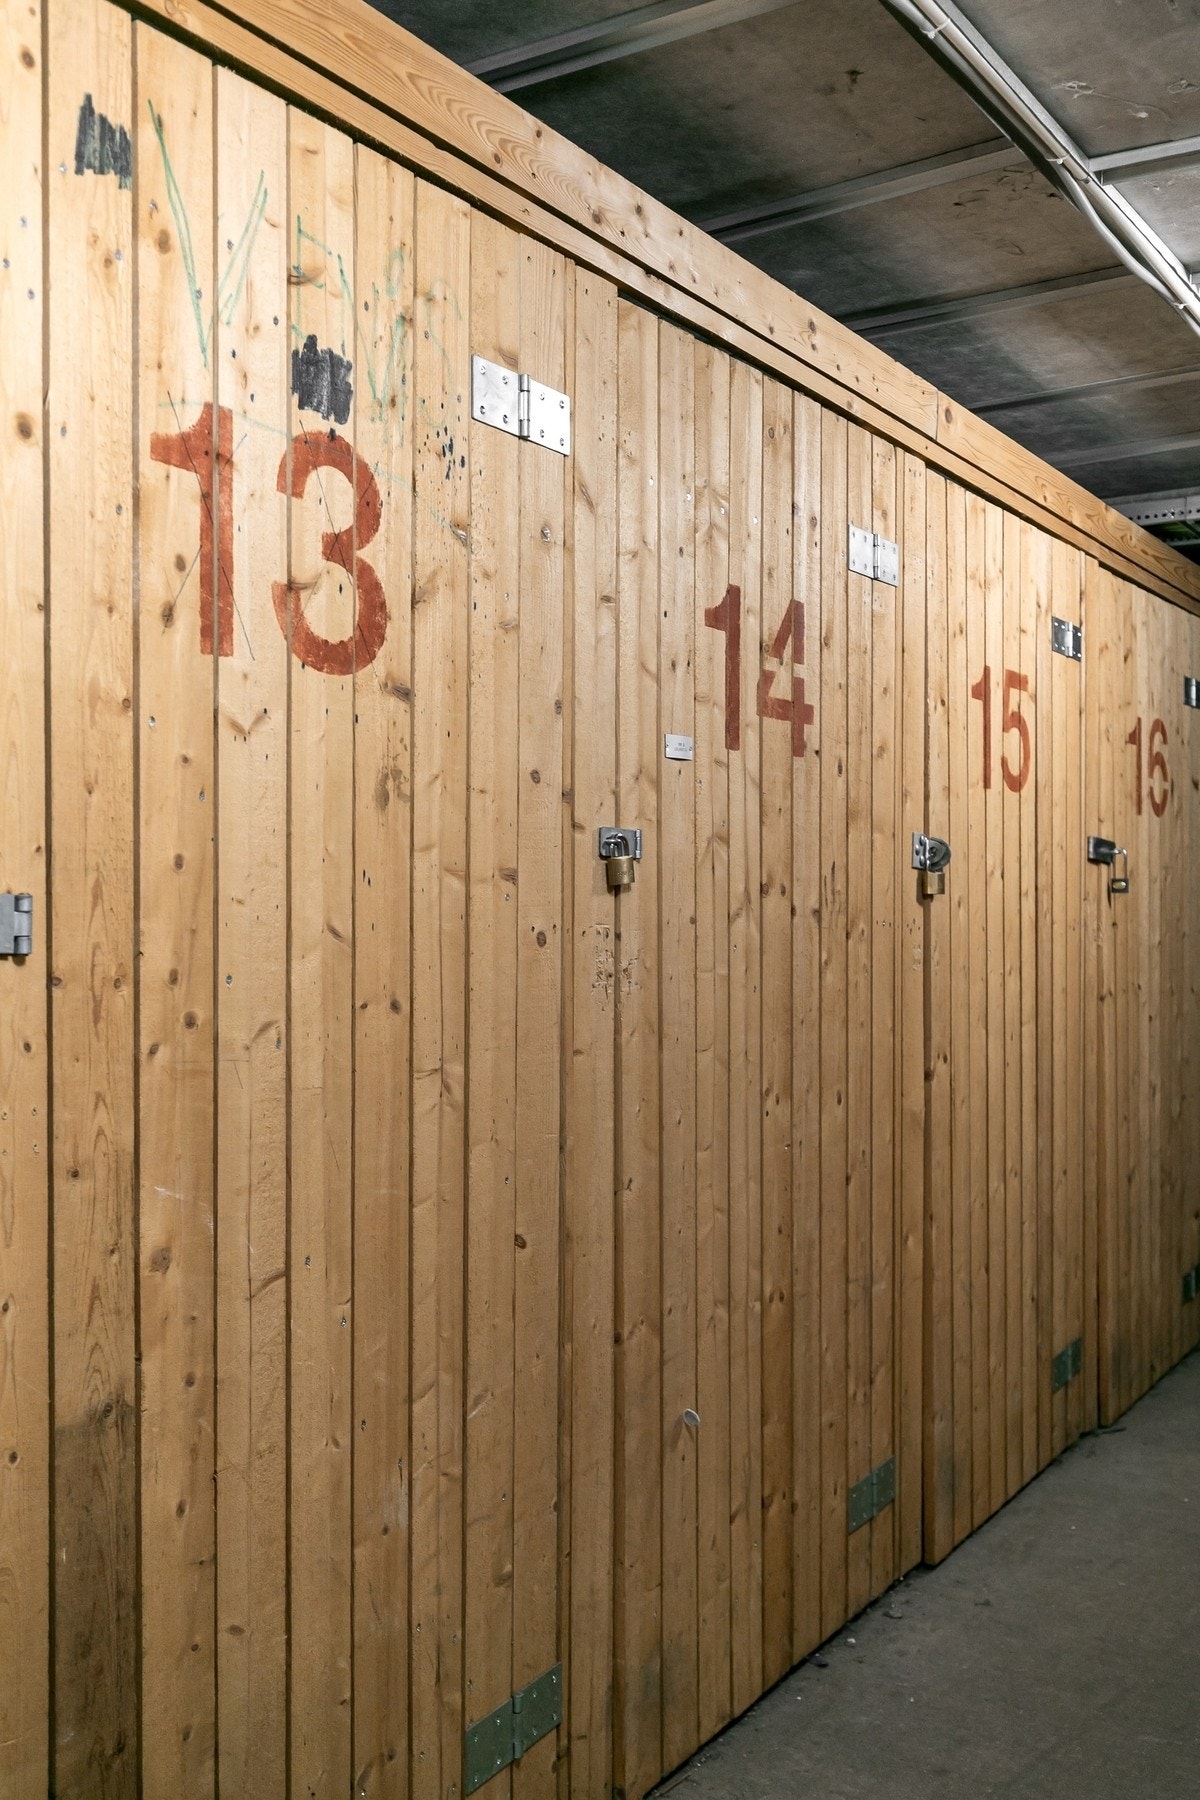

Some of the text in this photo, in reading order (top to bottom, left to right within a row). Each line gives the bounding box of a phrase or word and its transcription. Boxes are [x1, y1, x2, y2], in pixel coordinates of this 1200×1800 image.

[150, 401, 389, 676] 13
[704, 583, 815, 758] 14
[971, 665, 1031, 793] 15
[1125, 716, 1169, 818] 16
